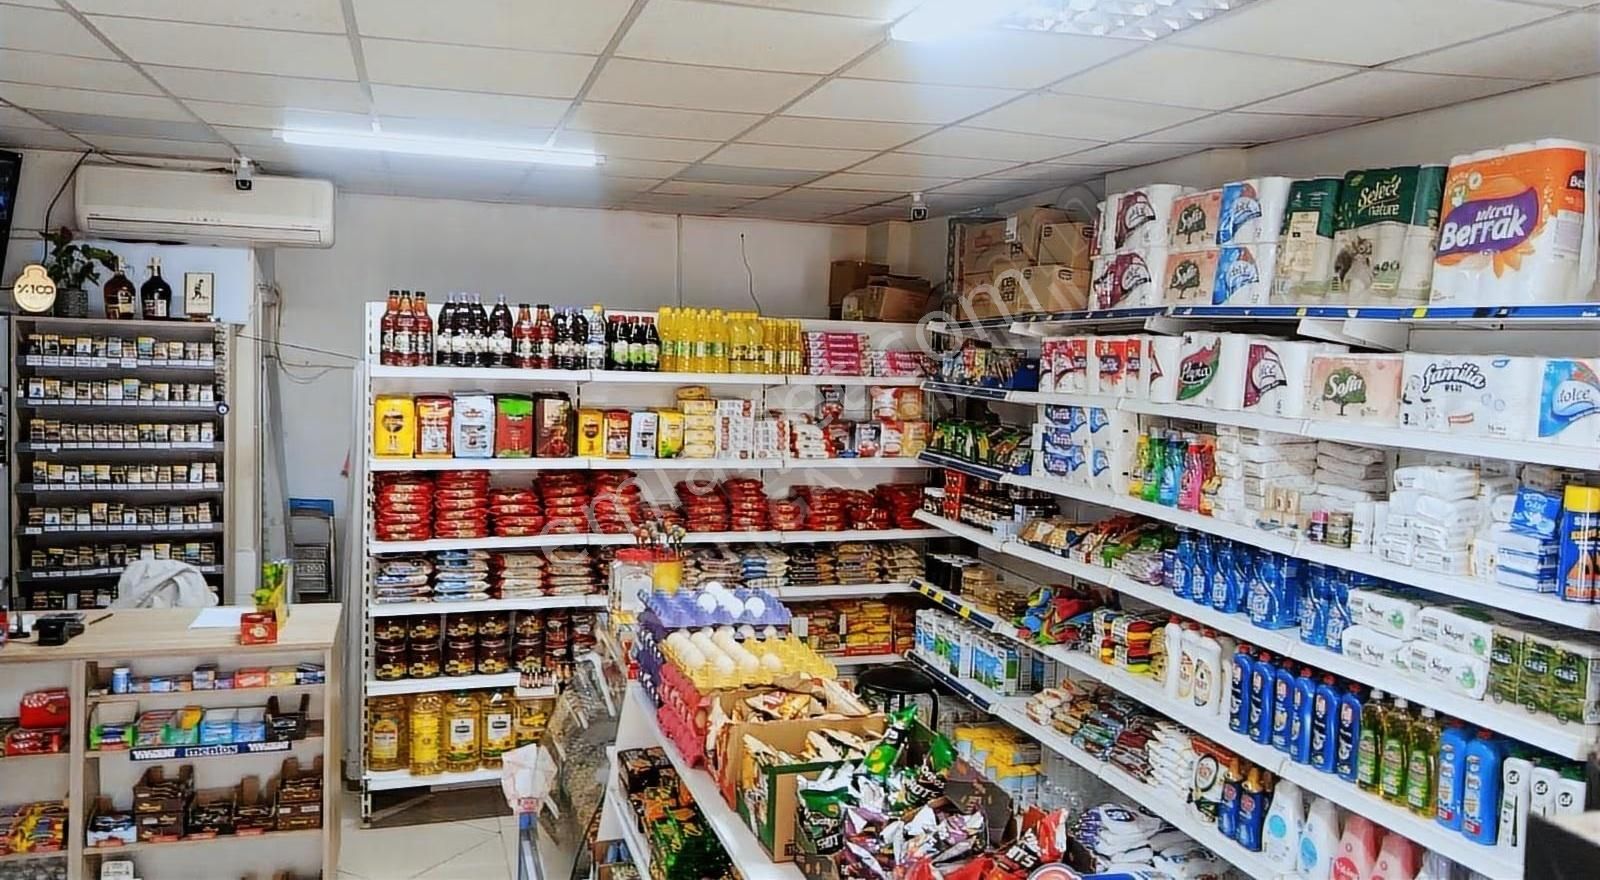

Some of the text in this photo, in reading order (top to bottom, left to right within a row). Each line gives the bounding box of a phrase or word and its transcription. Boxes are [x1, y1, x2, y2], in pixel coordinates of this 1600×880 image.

[1358, 177, 1401, 209] Select
[1368, 203, 1399, 216] nature
[1439, 207, 1528, 251] Berrak
[1325, 374, 1364, 399] Sofia
[1422, 362, 1487, 393] familia
[185, 744, 238, 757] mentos
